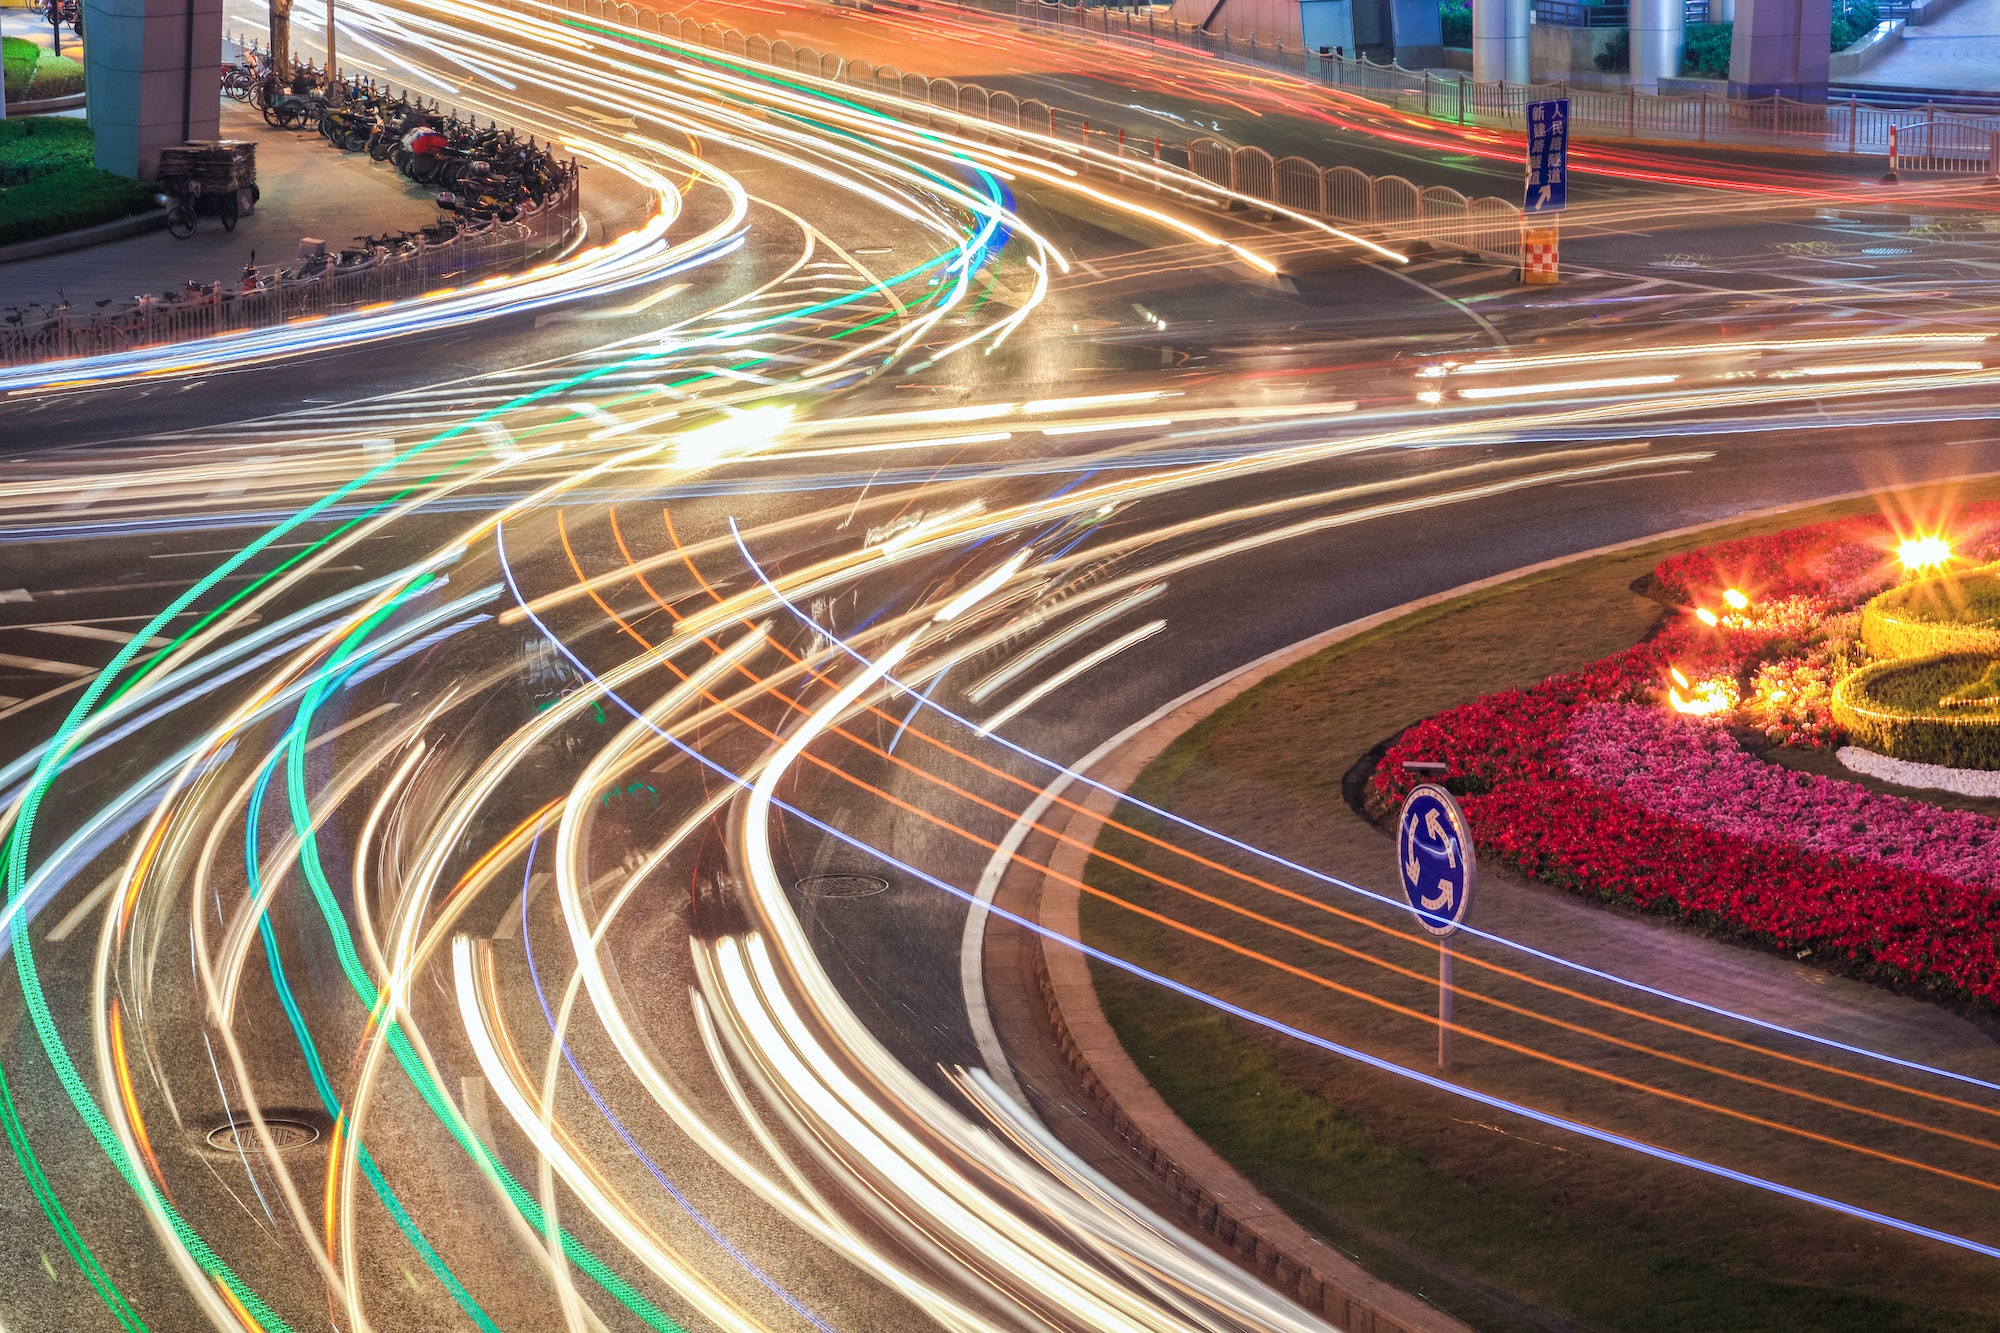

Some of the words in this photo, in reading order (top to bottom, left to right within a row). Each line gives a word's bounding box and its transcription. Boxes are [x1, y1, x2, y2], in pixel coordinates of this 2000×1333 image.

[1530, 106, 1546, 185] 新建路隧道
[1547, 103, 1563, 183] 人民路隧道
